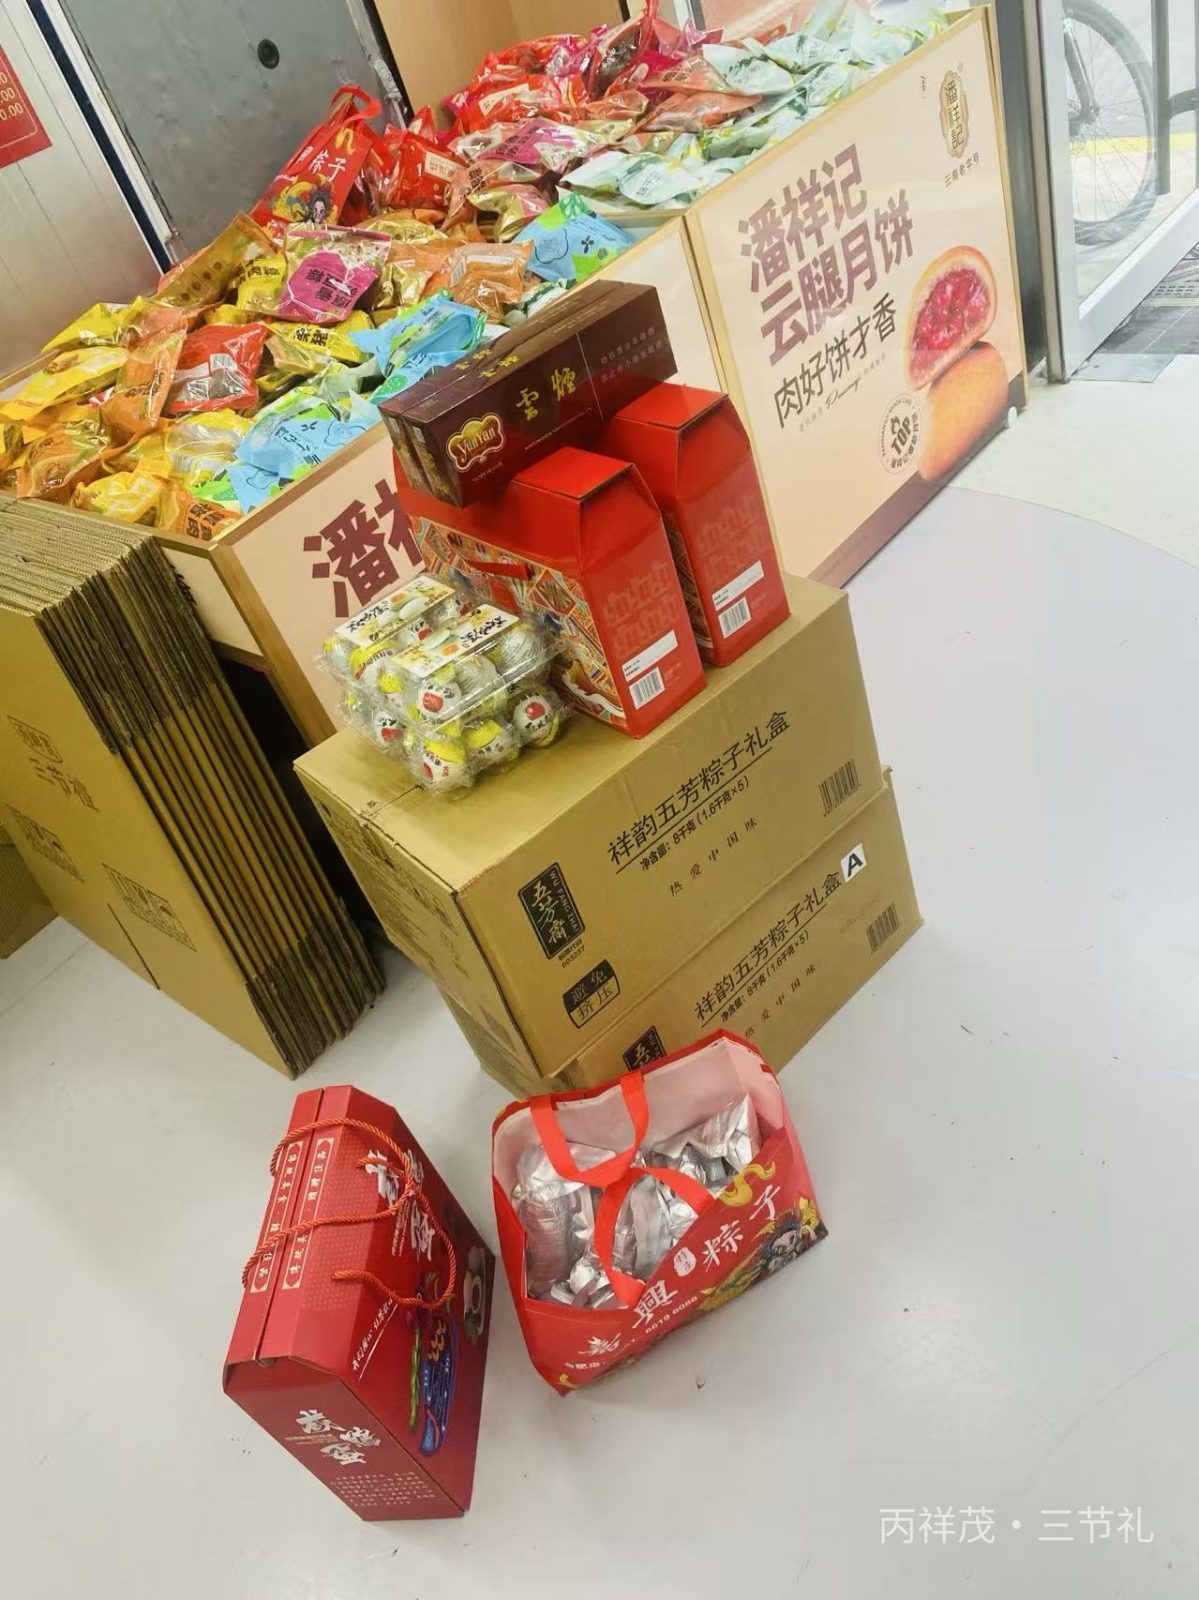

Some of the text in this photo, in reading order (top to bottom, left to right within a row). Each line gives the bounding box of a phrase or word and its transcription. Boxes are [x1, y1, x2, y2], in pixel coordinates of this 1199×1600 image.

[737, 143, 868, 293] 潘祥记
[760, 188, 914, 367] 云腿月饼
[774, 292, 896, 429] 肉好饼才香
[891, 416, 911, 456] TOP
[607, 710, 790, 866] 祥韵五芳粽子礼盒
[550, 869, 559, 886] WU
[847, 852, 864, 878] A
[570, 969, 608, 1003] 避免
[693, 871, 842, 1022] 祥韵五芳粽子礼盒
[577, 986, 614, 1020] 挤压
[702, 1184, 782, 1273] 粽子
